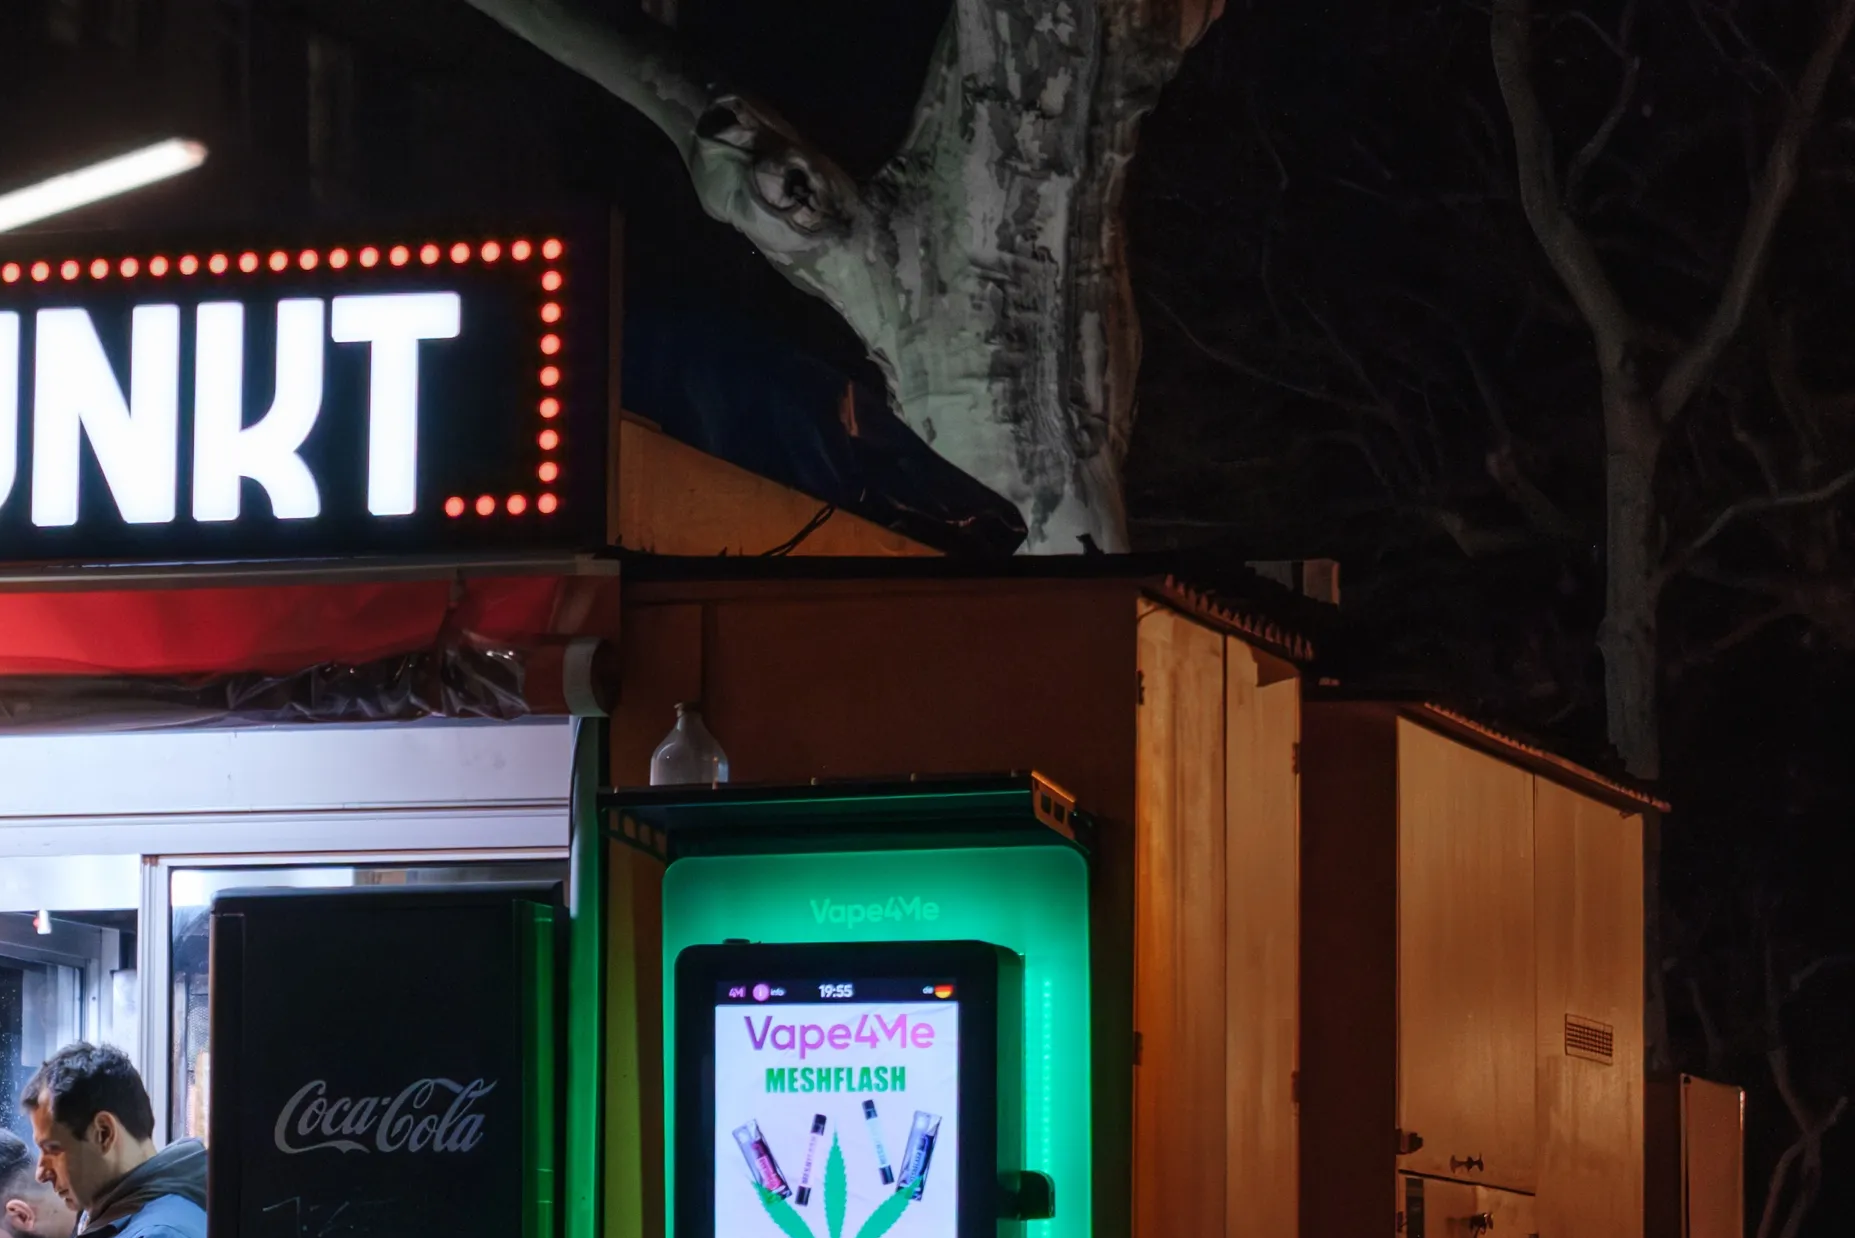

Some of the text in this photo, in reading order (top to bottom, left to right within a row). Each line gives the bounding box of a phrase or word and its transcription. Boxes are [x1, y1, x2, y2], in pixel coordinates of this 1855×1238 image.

[809, 895, 940, 929] Vape4Me
[819, 984, 854, 999] 19:55
[743, 1013, 936, 1060] Vape4Me
[765, 1065, 906, 1094] MESHFLASH
[275, 1077, 499, 1155] Coca-Cola
